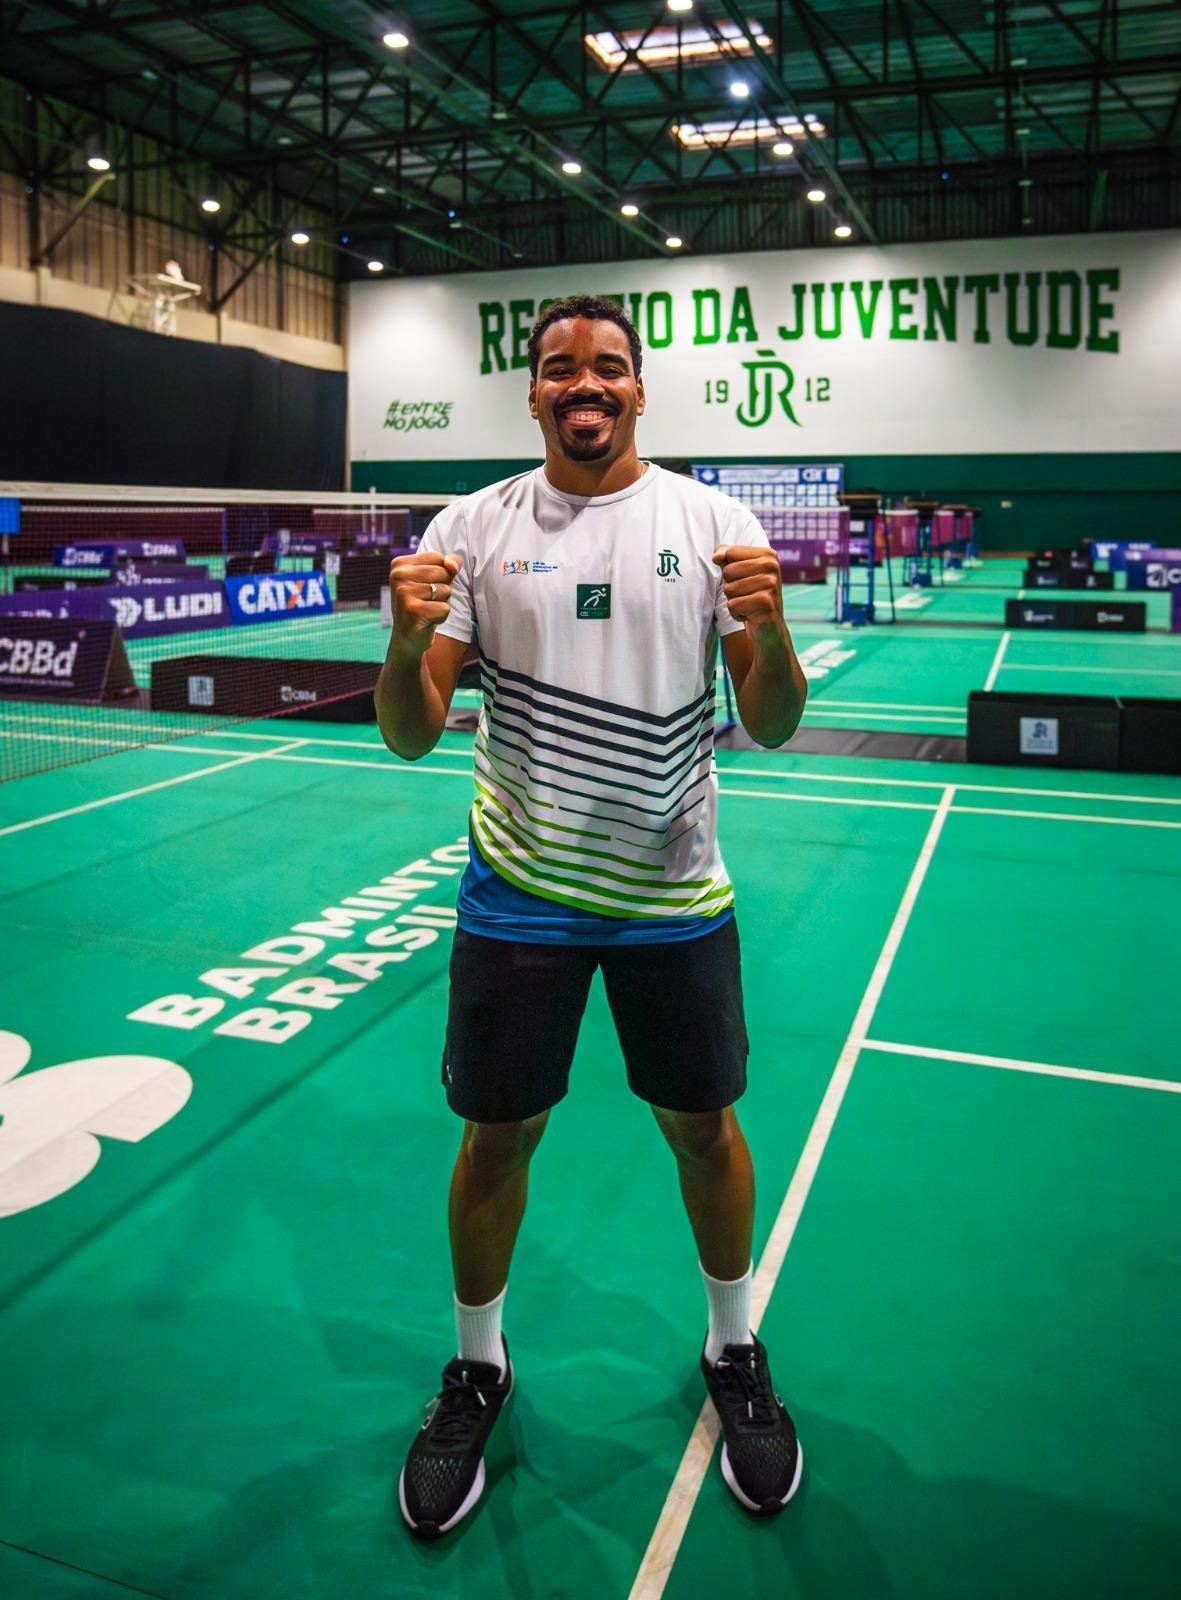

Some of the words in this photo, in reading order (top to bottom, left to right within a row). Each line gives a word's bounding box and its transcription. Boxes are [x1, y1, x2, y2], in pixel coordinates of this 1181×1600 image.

[479, 291, 672, 375] REIO
[692, 286, 758, 346] DA
[778, 268, 1120, 353] JUVENTUDE
[705, 380, 729, 404] 19
[805, 377, 831, 402] 12
[386, 399, 454, 418] #ENTRE
[143, 592, 222, 622] LUDI
[238, 577, 326, 615] CAIXA
[126, 836, 470, 1029] BADMINTO
